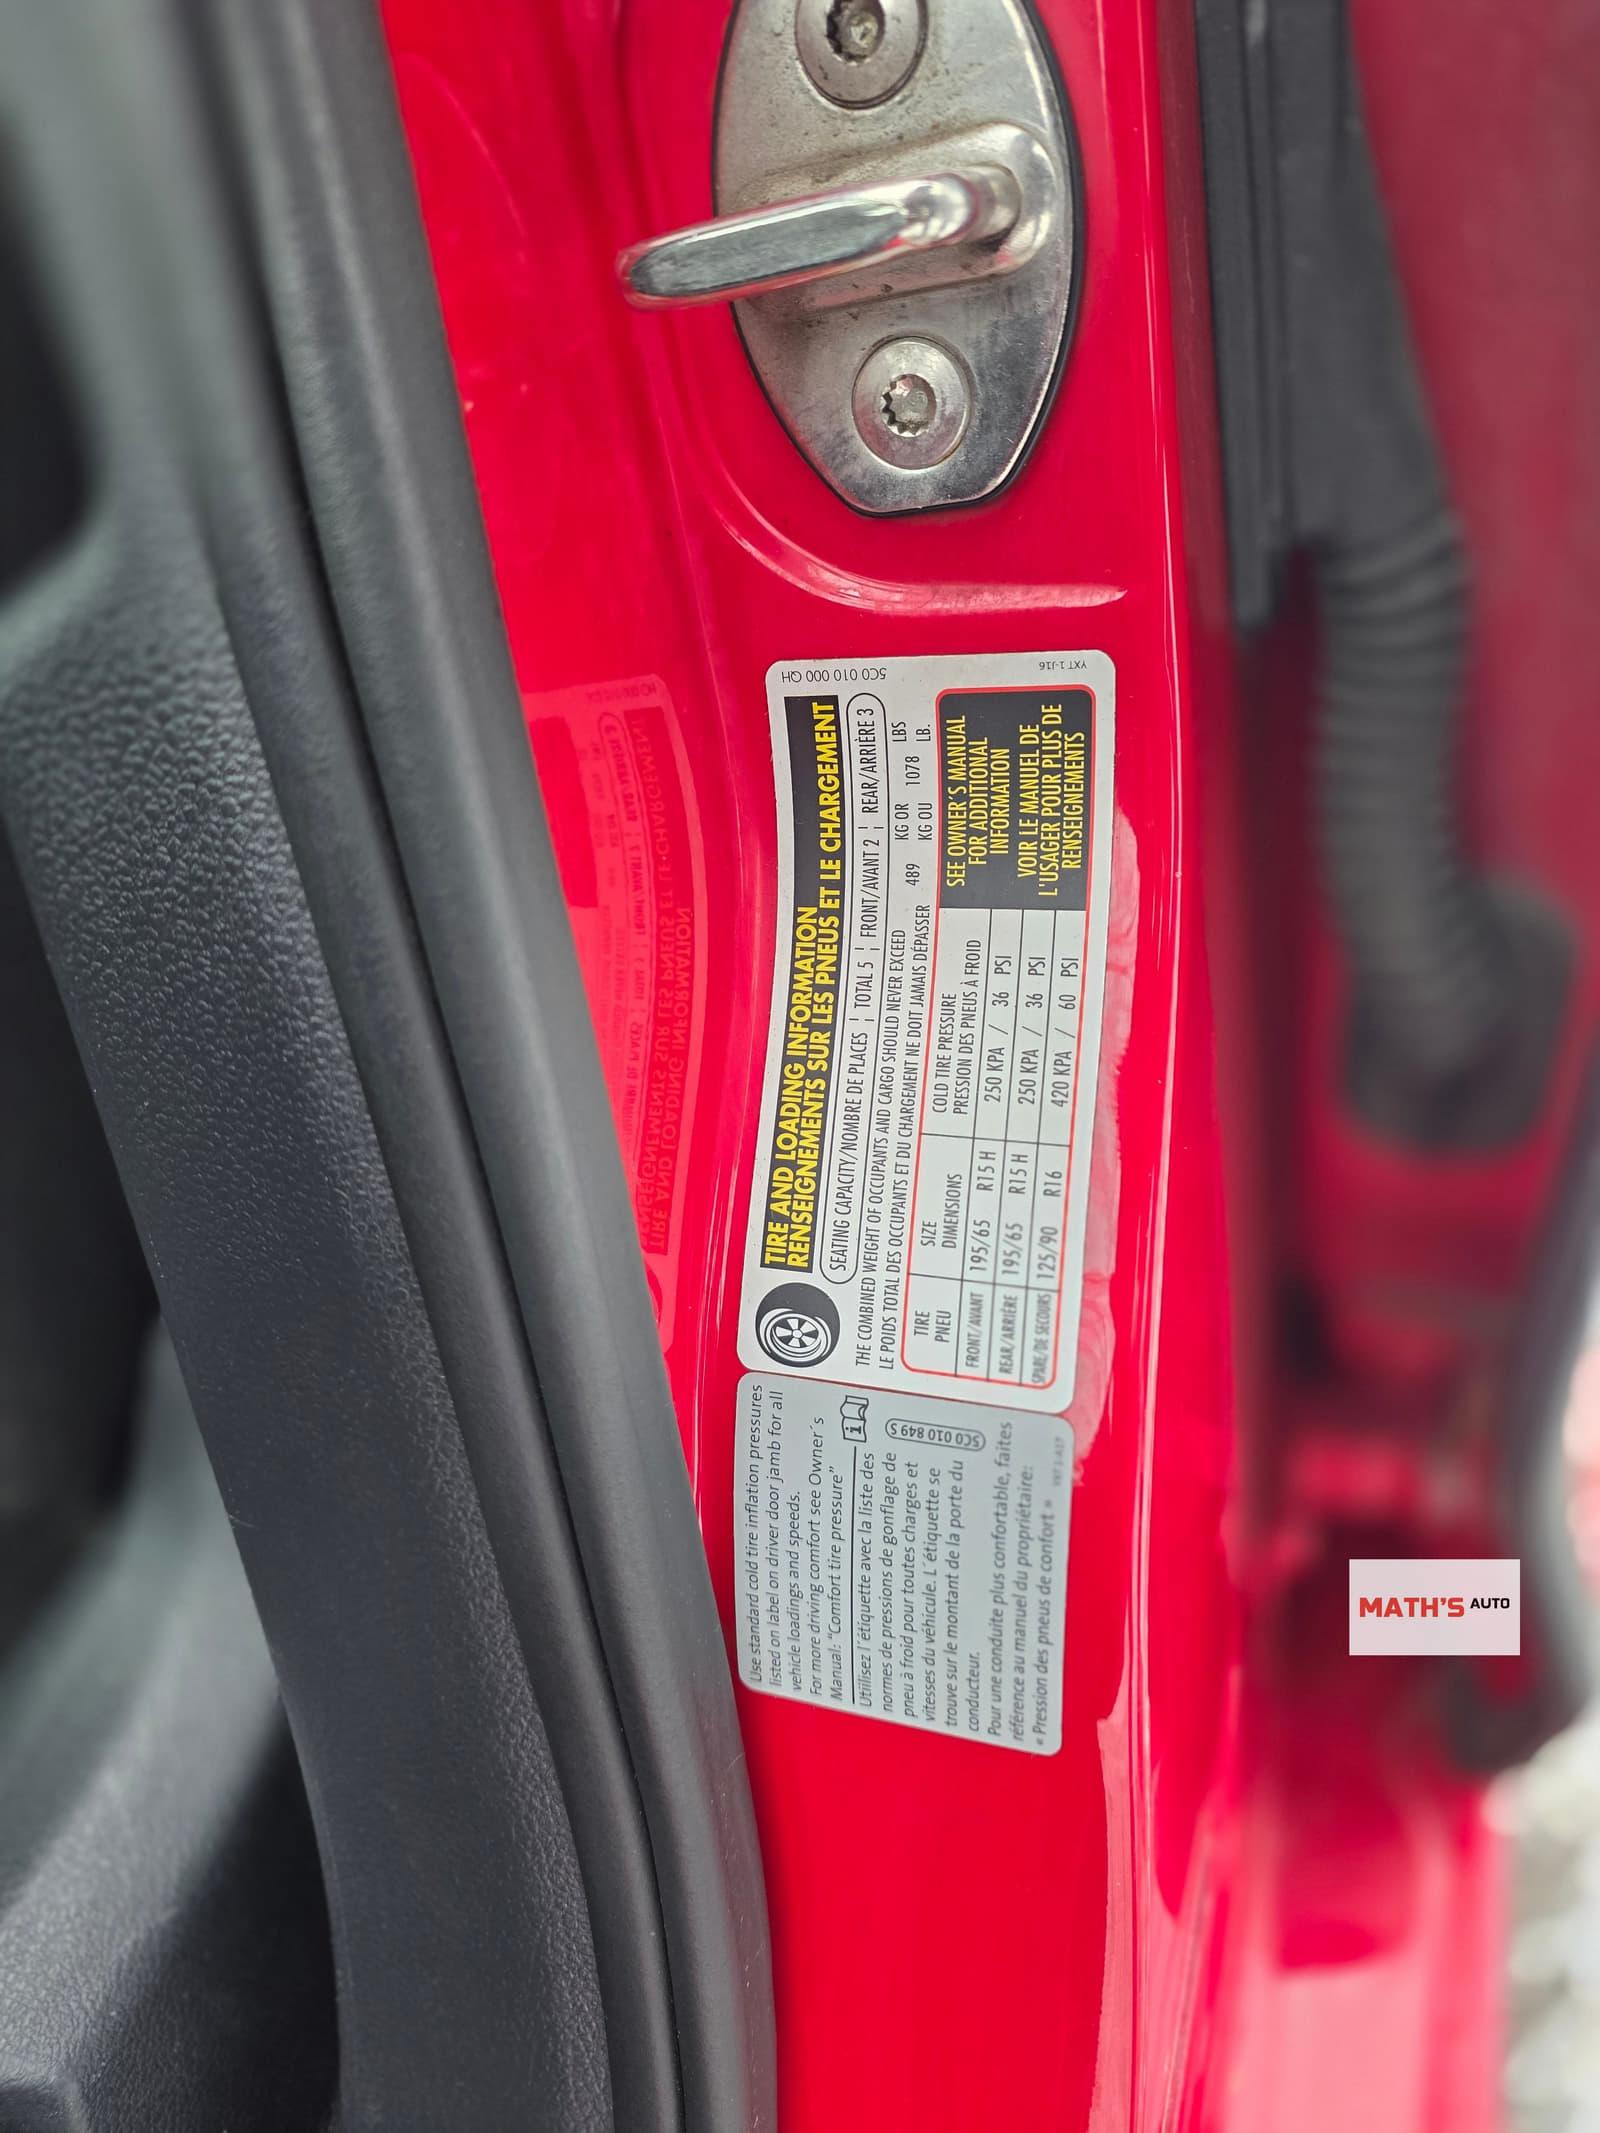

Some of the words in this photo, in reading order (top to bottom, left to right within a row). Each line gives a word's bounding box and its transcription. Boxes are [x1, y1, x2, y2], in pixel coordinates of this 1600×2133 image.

[782, 670, 802, 683] QH
[806, 670, 830, 682] 000
[834, 668, 858, 681] 010
[862, 668, 887, 680] 5C0
[856, 708, 874, 716] 3
[1041, 704, 1062, 724] DE
[891, 722, 907, 742] LBS
[915, 724, 931, 742] LB.
[946, 715, 967, 781] MANUAL
[1019, 724, 1039, 744] DE
[1041, 730, 1062, 768] PLUS
[814, 702, 840, 852] CHARGEMENT
[857, 720, 880, 813] REAR/ARRIÈRE
[904, 756, 920, 786] 1078
[1019, 749, 1039, 814] MANUEL
[968, 737, 988, 831] ADDITIONAL
[1041, 774, 1061, 816] POUR
[1061, 732, 1084, 868] RENSEIGNEMENTS
[894, 803, 909, 820] OR
[917, 803, 933, 820] OU
[989, 749, 1010, 854] INFORMATION
[894, 824, 909, 840] KG
[917, 824, 933, 840] KG
[1018, 819, 1038, 835] LE
[968, 836, 988, 864] FOR
[1017, 841, 1038, 878] VOIR
[820, 859, 841, 880] LE
[905, 864, 920, 886] 489
[946, 861, 966, 887] SEE
[819, 886, 840, 909] ET
[860, 850, 880, 938] FRONT/AVANT
[910, 905, 930, 961] DÉPASSER
[815, 916, 838, 985] PNEUS
[889, 930, 906, 972] EXCEED
[964, 940, 981, 975] FROID
[994, 956, 1012, 975] PSI
[1027, 957, 1046, 976] PSI
[786, 907, 818, 1056] INFORMATION
[1060, 958, 1079, 977] PSI
[854, 973, 873, 1009] TOTAL
[886, 976, 903, 1012] NEVER
[909, 966, 927, 1008] JAMAIS
[960, 980, 979, 988] À
[991, 992, 1009, 1007] 36
[812, 992, 834, 1024] LES
[960, 991, 978, 1029] PNEUS
[1025, 993, 1043, 1009] 36
[1058, 994, 1076, 1010] 60
[906, 1010, 923, 1038] DOIT
[937, 993, 957, 1051] PRESSURE
[807, 1032, 831, 1072] SUR
[848, 1032, 868, 1075] PLACES
[881, 1016, 899, 1062] SHOULD
[905, 1041, 920, 1057] NE
[958, 1033, 974, 1054] DES
[935, 1054, 951, 1079] TIRE
[986, 1047, 1005, 1072] KPA
[1020, 1049, 1039, 1074] KPA
[1052, 1051, 1072, 1076] KPA
[846, 1078, 864, 1095] DE
[877, 1066, 895, 1105] CARGO
[898, 1060, 918, 1138] CHARGEMENT
[932, 1083, 949, 1113] COLD
[952, 1058, 972, 1115] PRESSION
[983, 1077, 1002, 1103] 250
[1017, 1079, 1036, 1105] 250
[1050, 1081, 1069, 1108] 420
[776, 1063, 804, 1161] LOADING
[875, 1109, 891, 1135] AND
[834, 1098, 862, 1215] CAPACITY/NOMBRE
[896, 1142, 911, 1159] DU
[979, 1151, 996, 1161] H
[1010, 1154, 1028, 1164] H
[788, 1078, 826, 1267] RENSEIGNEMENTS
[868, 1137, 888, 1204] OCCUPANTS
[894, 1162, 909, 1175] ET
[976, 1165, 995, 1192] R15
[1008, 1168, 1027, 1195] R15
[1042, 1171, 1062, 1197] R16
[772, 1167, 794, 1217] AND
[866, 1208, 882, 1224] OF
[888, 1179, 908, 1247] OCCUPANTS
[941, 1174, 962, 1249] DIMENSIONS
[766, 1222, 789, 1264] TIRE
[829, 1220, 850, 1271] SEATING
[862, 1226, 880, 1273] WEIGHT
[920, 1221, 937, 1247] SIZE
[969, 1220, 990, 1271] 195/65
[1001, 1223, 1023, 1275] 195/65
[885, 1251, 902, 1273] DES
[1036, 1226, 1058, 1279] 125/90
[857, 1277, 876, 1341] COMBINED
[882, 1277, 900, 1312] TOTAL
[880, 1316, 897, 1353] POIDS
[913, 1310, 930, 1336] TIRE
[934, 1310, 951, 1343] PNEU
[965, 1292, 984, 1368] FRONT/AVANT
[855, 1344, 871, 1366] THE
[879, 1356, 894, 1370] LE
[769, 1391, 783, 1410] all
[749, 1385, 764, 1460] pressures
[767, 1413, 782, 1437] for
[994, 1422, 1012, 1468] faites
[766, 1441, 784, 1484] jamb
[881, 1452, 896, 1472] de
[744, 1464, 759, 1528] inflation
[765, 1484, 779, 1520] door
[810, 1490, 821, 1516] see
[879, 1476, 899, 1546] gonflage
[786, 1491, 803, 1547] speeds.
[990, 1472, 1011, 1569] confortable,
[745, 1532, 758, 1558] tire
[765, 1523, 779, 1567] driver
[806, 1519, 820, 1580] comfort
[827, 1544, 841, 1570] tire
[878, 1548, 893, 1567] de
[744, 1560, 758, 1591] cold
[769, 1570, 779, 1589] on
[785, 1550, 799, 1579] and
[878, 1571, 896, 1639] pressions
[989, 1573, 1008, 1606] plus
[745, 1592, 761, 1656] standard
[765, 1592, 780, 1627] label
[786, 1582, 803, 1642] loadings
[806, 1583, 824, 1634] driving
[770, 1630, 780, 1648] on
[810, 1636, 821, 1673] more
[878, 1641, 892, 1659] de
[987, 1608, 1004, 1674] conduite
[749, 1657, 762, 1683] Use
[767, 1650, 782, 1687] listed
[787, 1645, 802, 1691] vehicle
[827, 1644, 842, 1701] Manual:
[809, 1674, 822, 1696] For
[882, 1662, 893, 1713] normes
[991, 1676, 1002, 1703] une
[987, 1705, 1002, 1737] Pour
